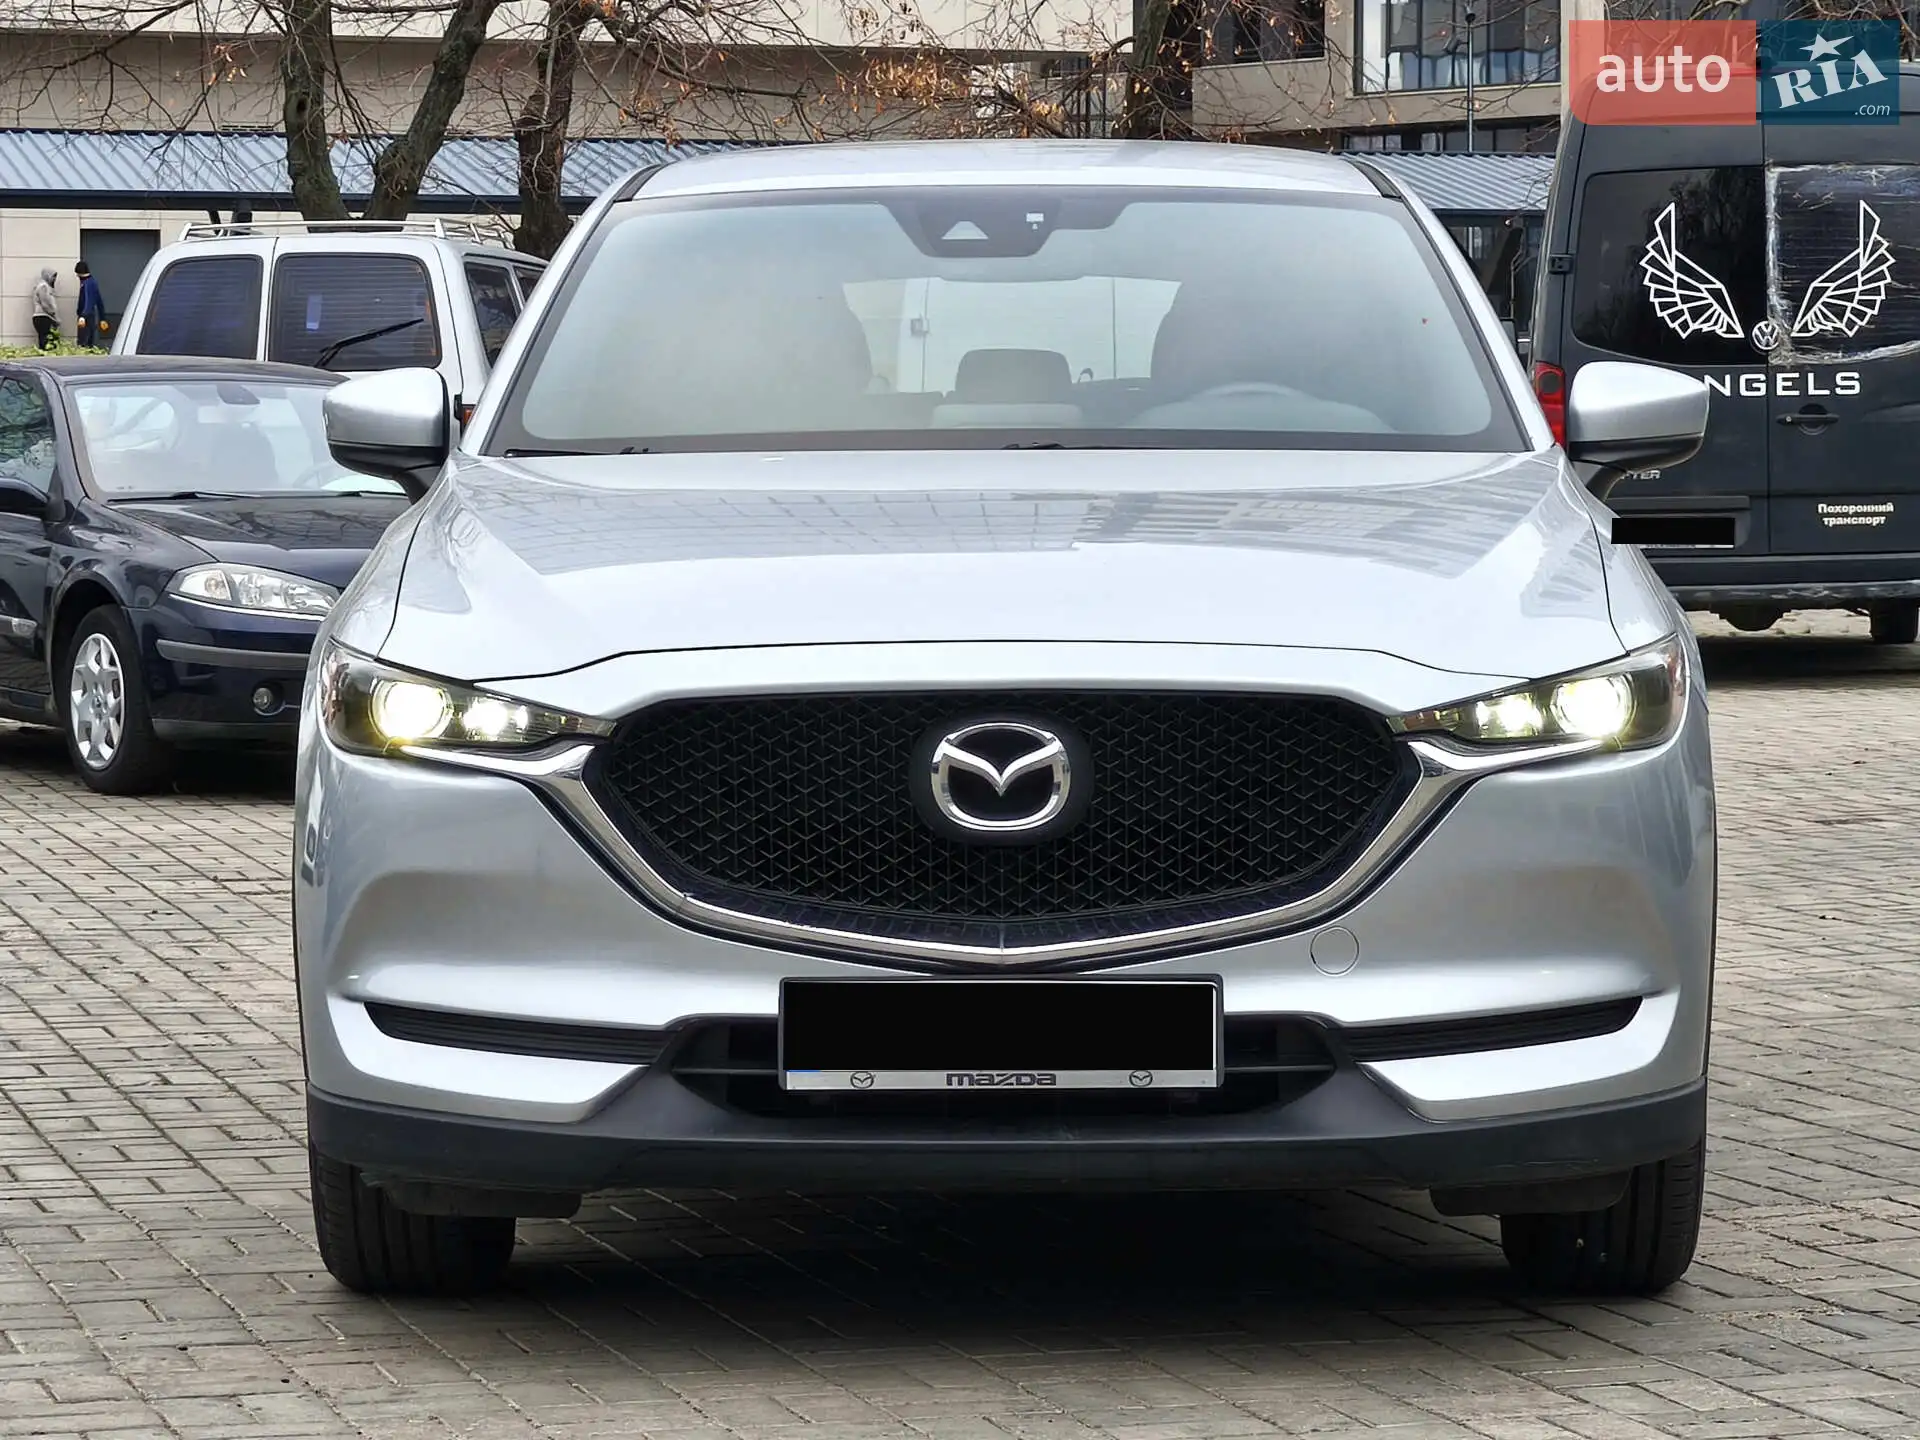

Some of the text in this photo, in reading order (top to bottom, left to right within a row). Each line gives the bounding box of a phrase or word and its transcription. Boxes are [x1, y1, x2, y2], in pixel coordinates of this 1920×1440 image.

[1704, 371, 1861, 397] NGELS
[1817, 502, 1894, 515] Похоронний
[1822, 516, 1887, 527] транспорт
